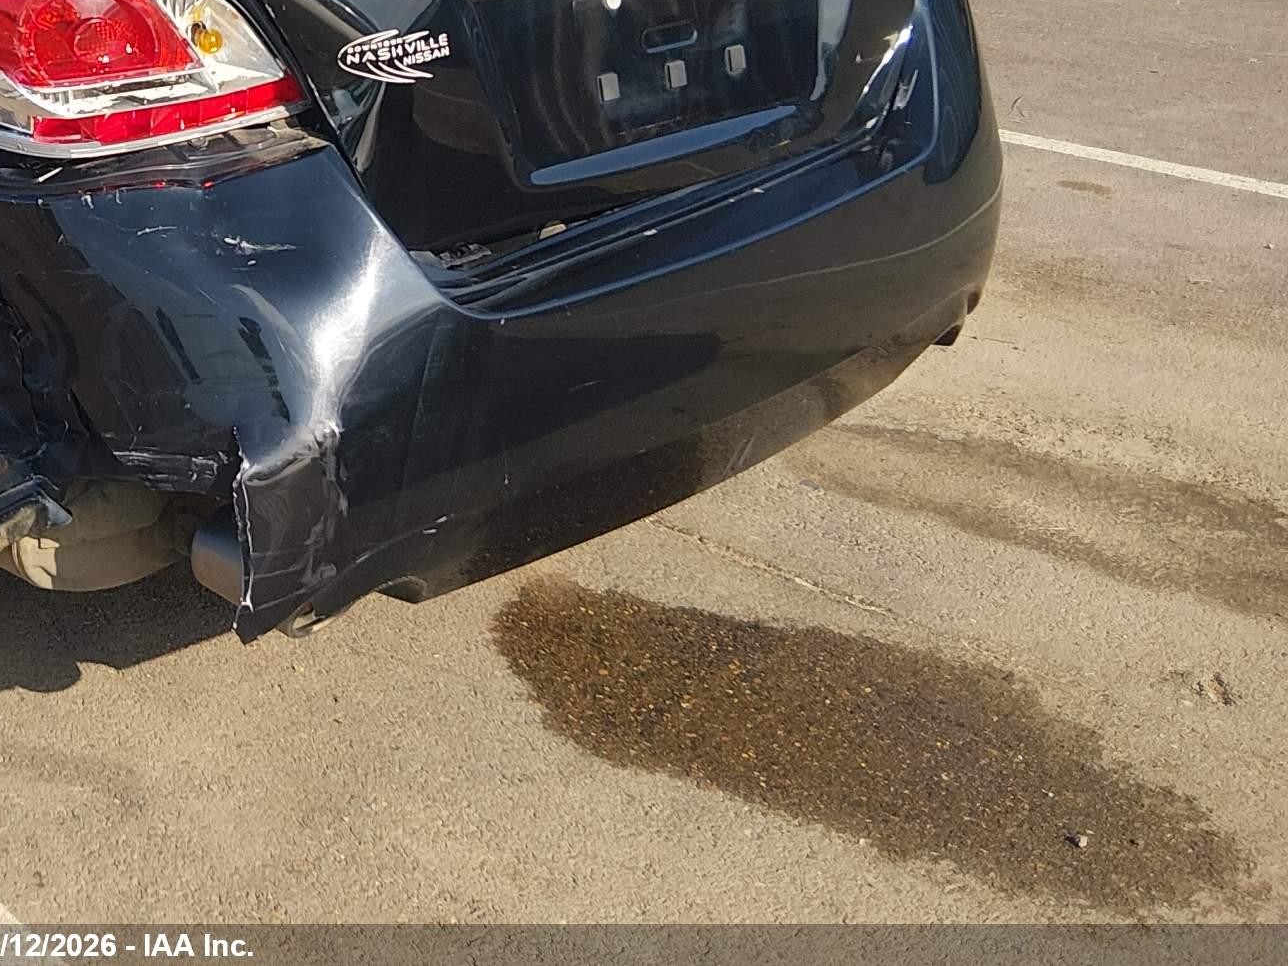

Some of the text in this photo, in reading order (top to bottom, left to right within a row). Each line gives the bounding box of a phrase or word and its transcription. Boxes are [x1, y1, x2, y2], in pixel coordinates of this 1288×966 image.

[346, 33, 449, 66] NASHVILLE
[347, 37, 404, 54] DOWNTOWN
[402, 46, 450, 66] NISSAN
